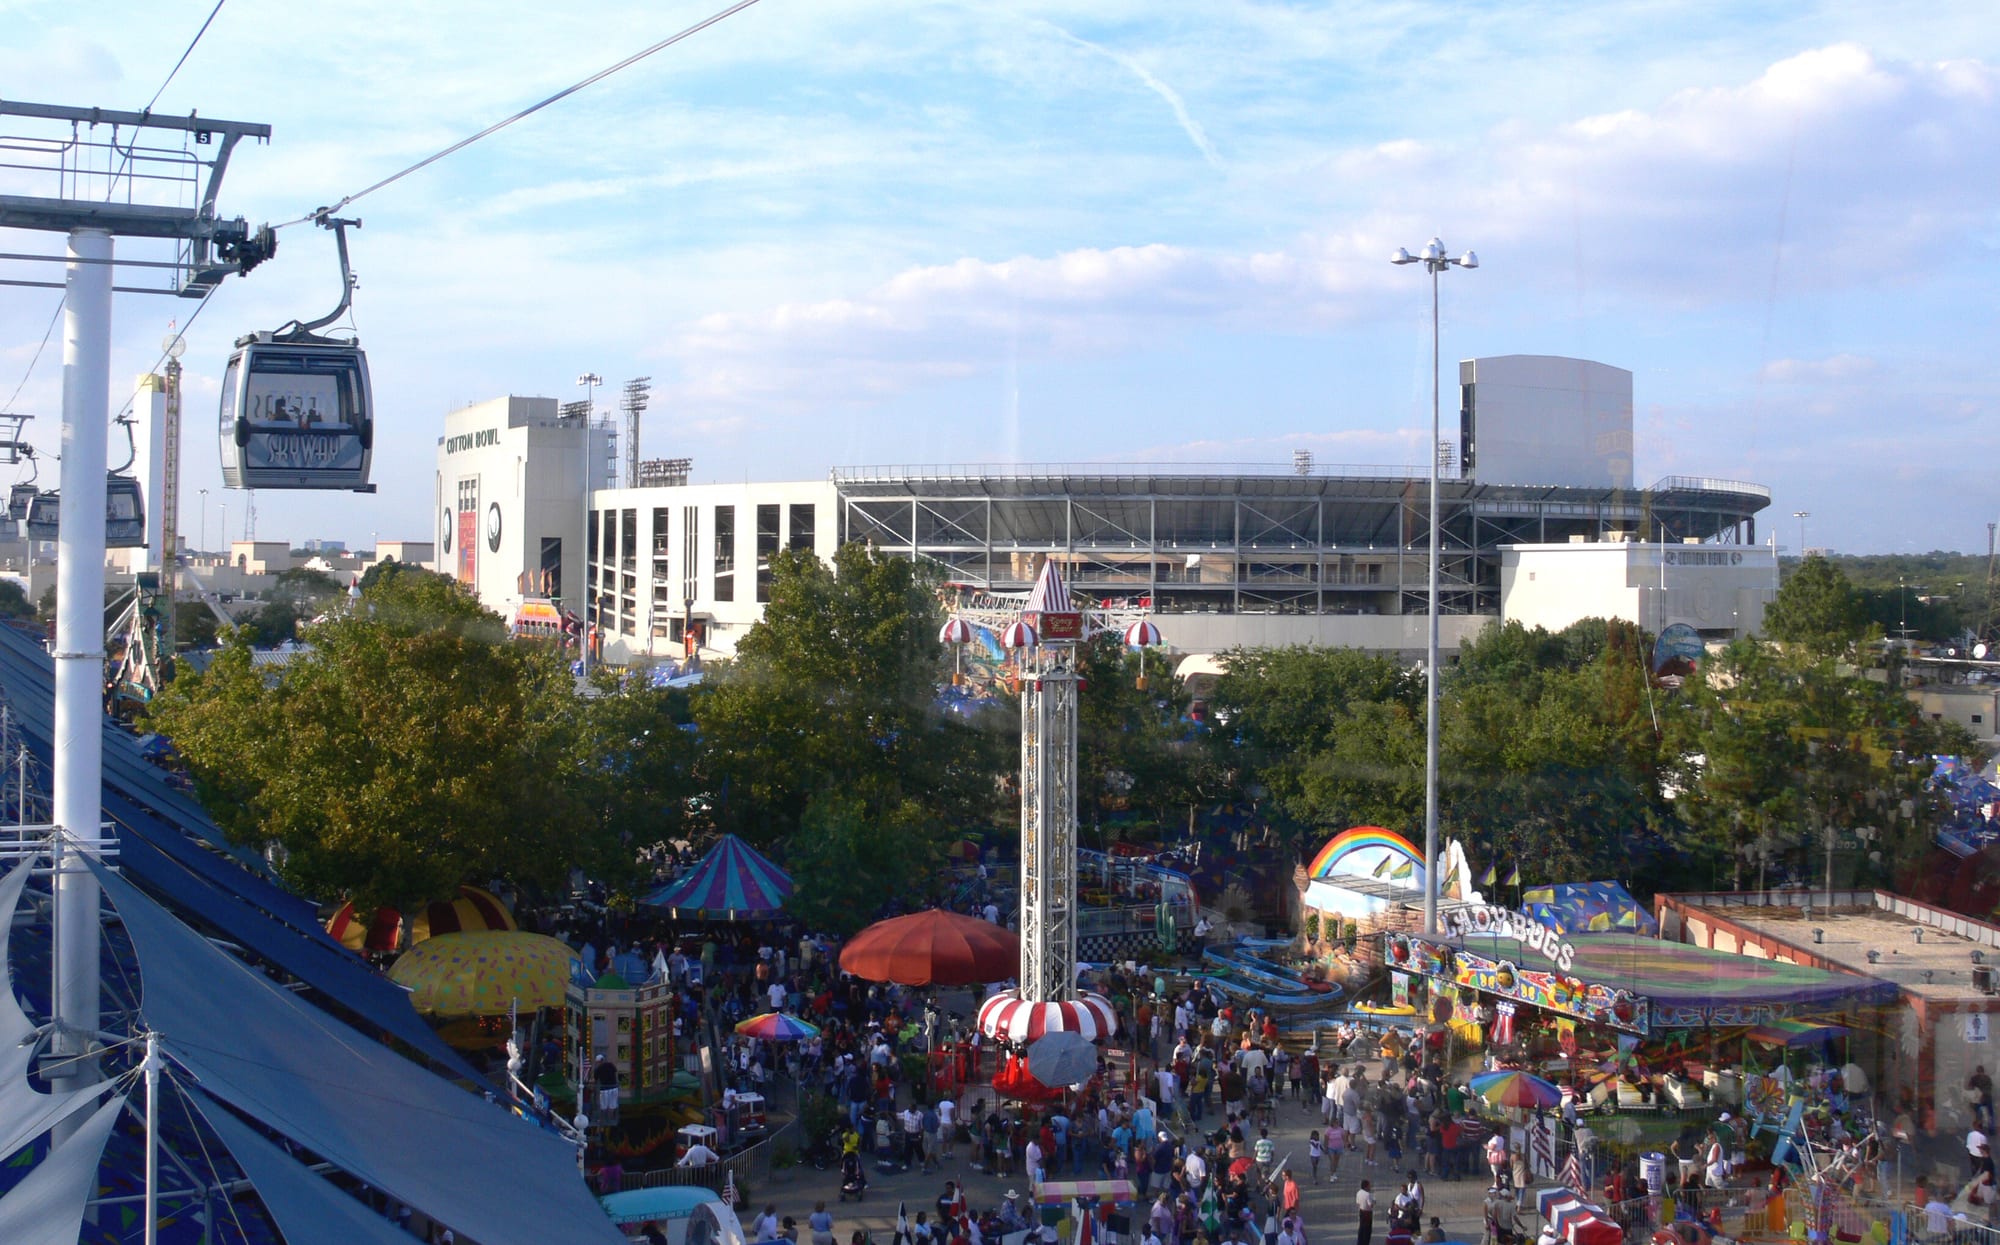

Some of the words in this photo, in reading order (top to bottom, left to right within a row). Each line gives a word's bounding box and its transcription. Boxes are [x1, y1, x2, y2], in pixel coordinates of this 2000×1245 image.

[200, 133, 208, 144] 5
[267, 434, 340, 463] SKYWAY
[447, 433, 473, 455] COTTON
[475, 429, 501, 448] BOWL
